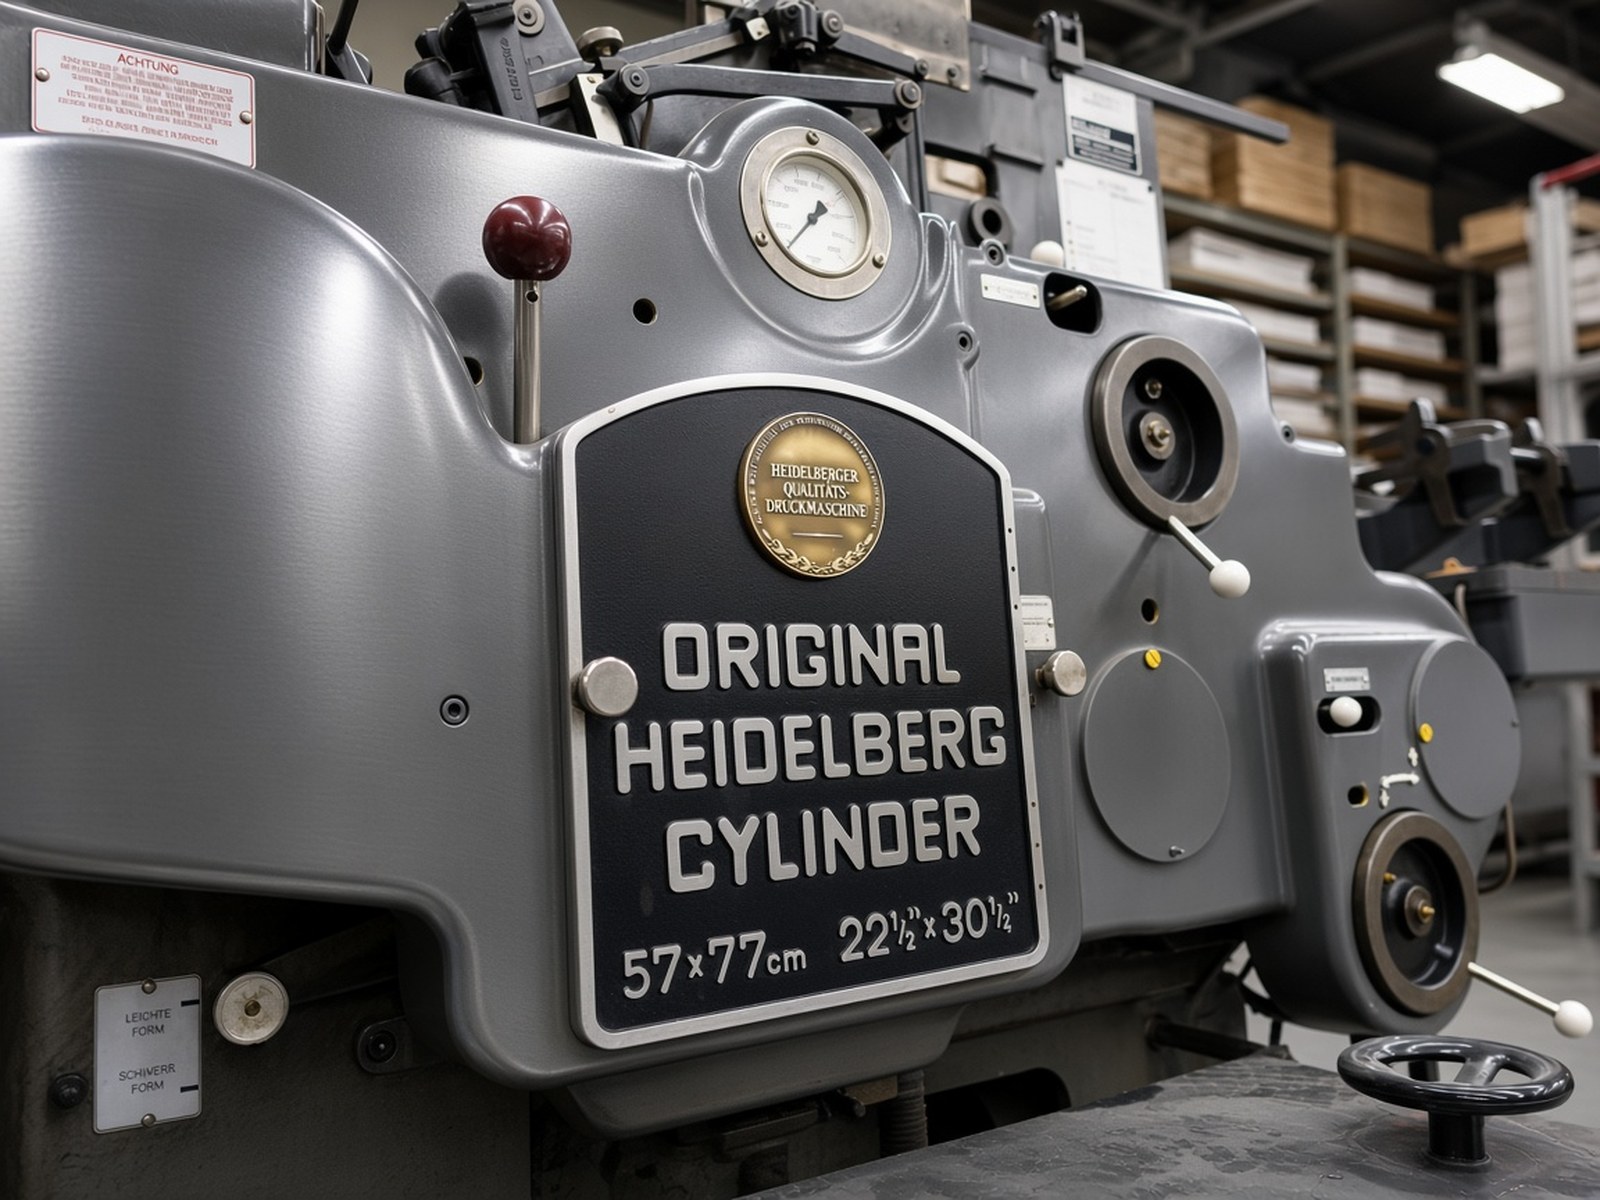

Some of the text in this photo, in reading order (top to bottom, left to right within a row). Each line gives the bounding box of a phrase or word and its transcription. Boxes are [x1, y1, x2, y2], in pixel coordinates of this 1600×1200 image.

[117, 53, 179, 75] ACHTUNG
[770, 463, 859, 483] HEIDELBERGER
[765, 499, 869, 518] DRUCKMASCHINE
[663, 622, 961, 691] ORIGINAL
[614, 705, 1007, 794] HEIDELBERG
[666, 794, 981, 893] CYLINDER
[125, 1008, 171, 1023] LEICHTE
[132, 1024, 165, 1037] FORM
[131, 1080, 164, 1094] FORM
